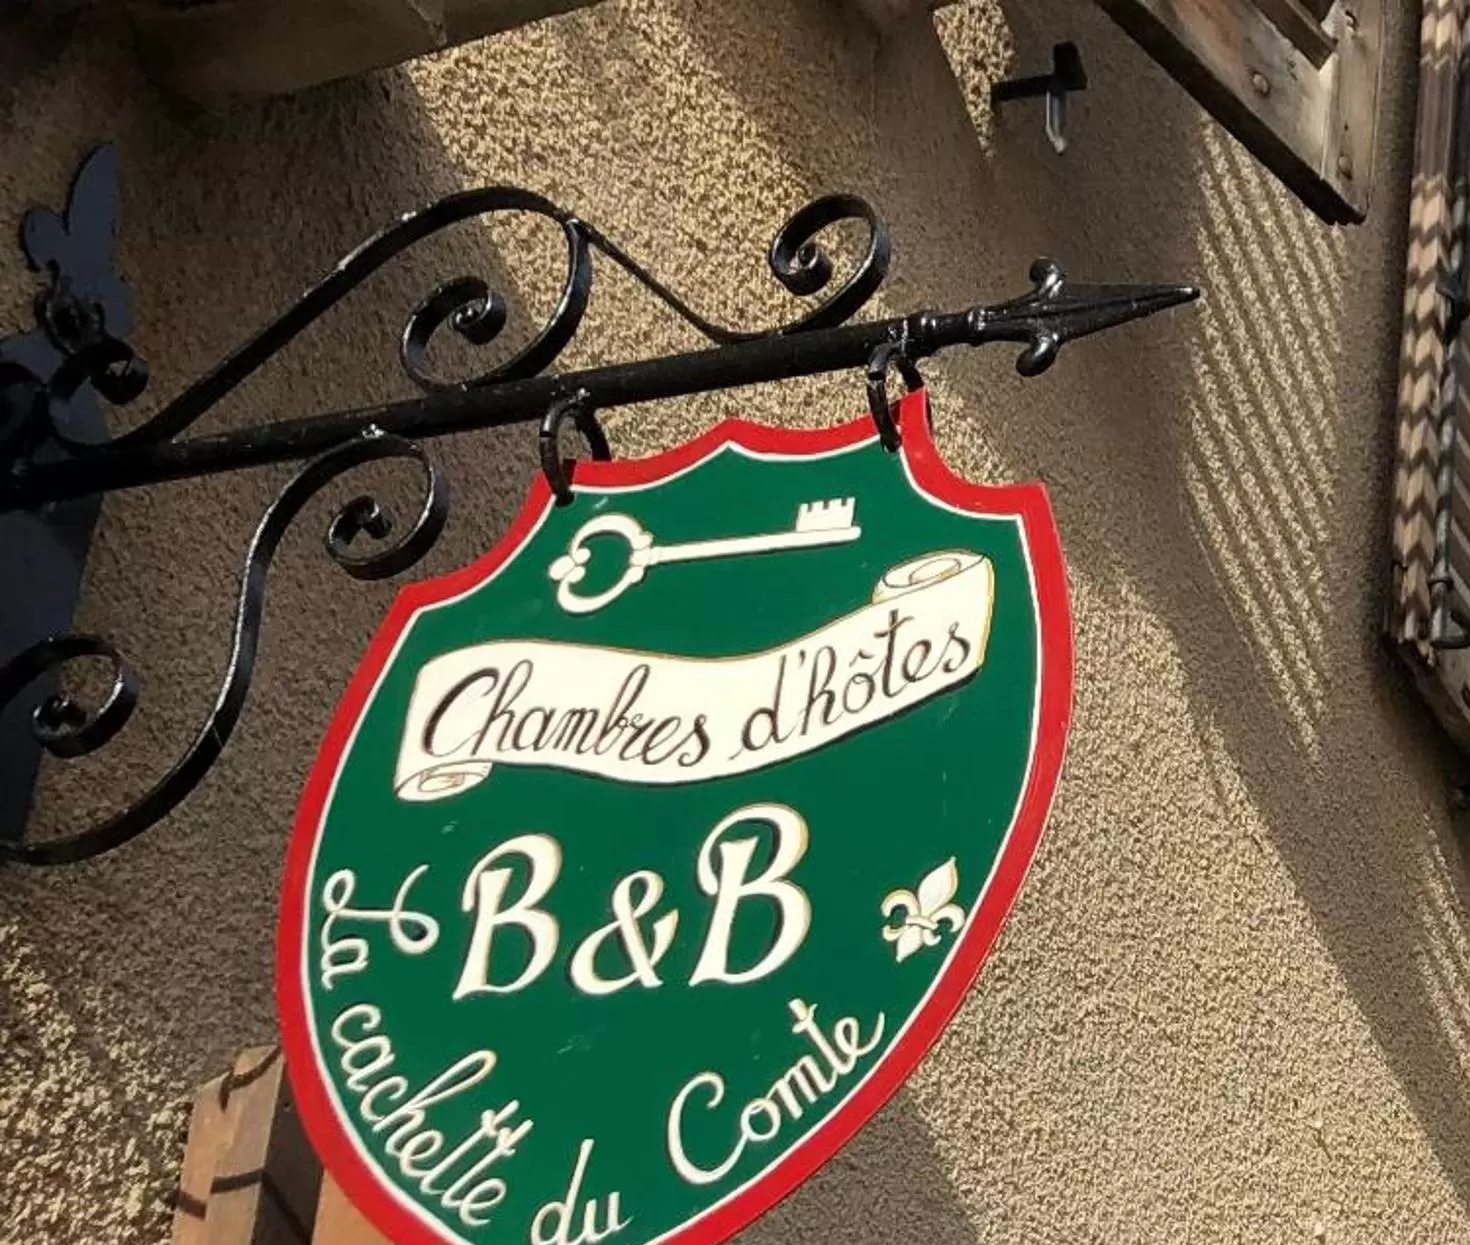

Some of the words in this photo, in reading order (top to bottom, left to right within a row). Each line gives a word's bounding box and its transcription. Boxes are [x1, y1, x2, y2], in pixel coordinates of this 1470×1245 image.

[422, 659, 709, 767] Chambres
[730, 609, 971, 760] d'hôtes
[321, 866, 439, 990] La
[331, 1003, 532, 1227] cachette
[667, 997, 885, 1184] Comte
